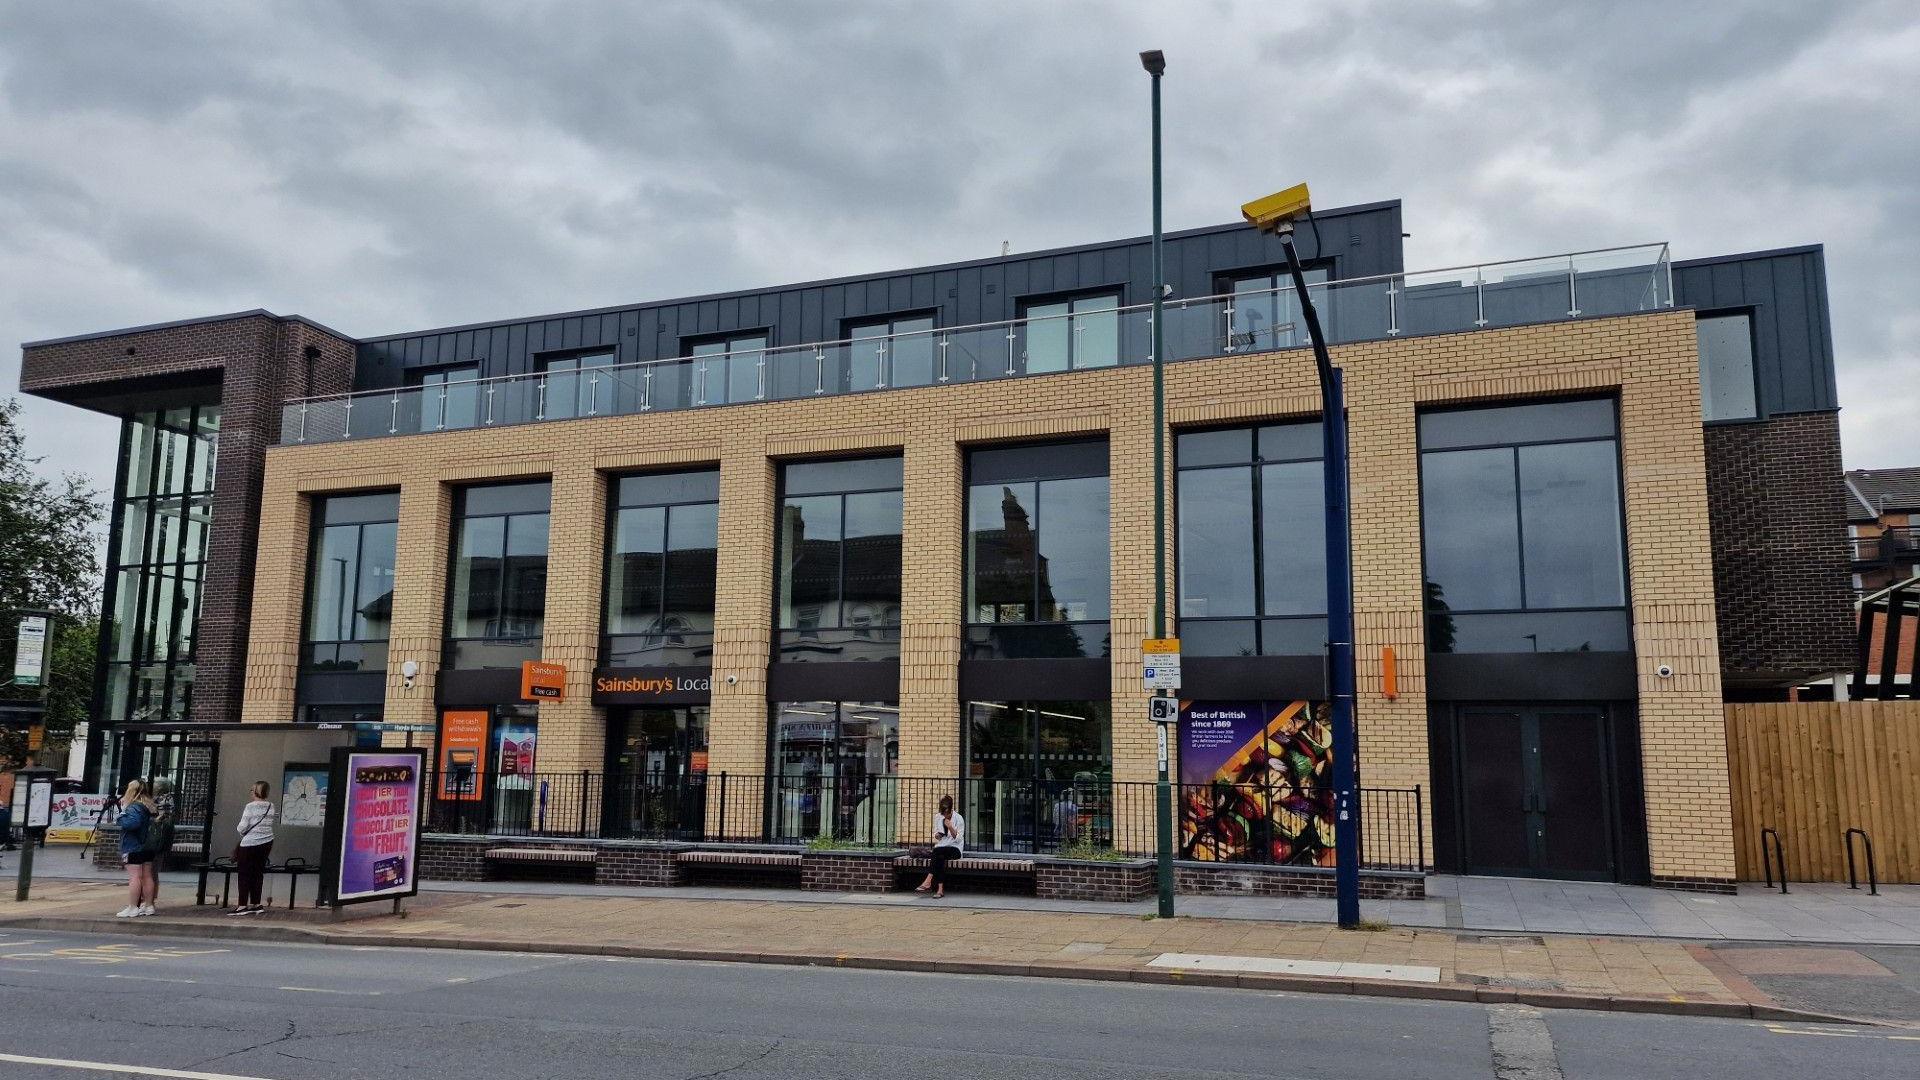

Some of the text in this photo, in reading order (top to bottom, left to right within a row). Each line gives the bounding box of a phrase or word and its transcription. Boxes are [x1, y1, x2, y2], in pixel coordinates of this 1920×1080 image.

[597, 677, 673, 694] Sainsbury's
[1219, 711, 1246, 719] British
[1191, 720, 1231, 728] since 1869
[81, 796, 101, 806] Save
[375, 832, 408, 855] FRUIT.
